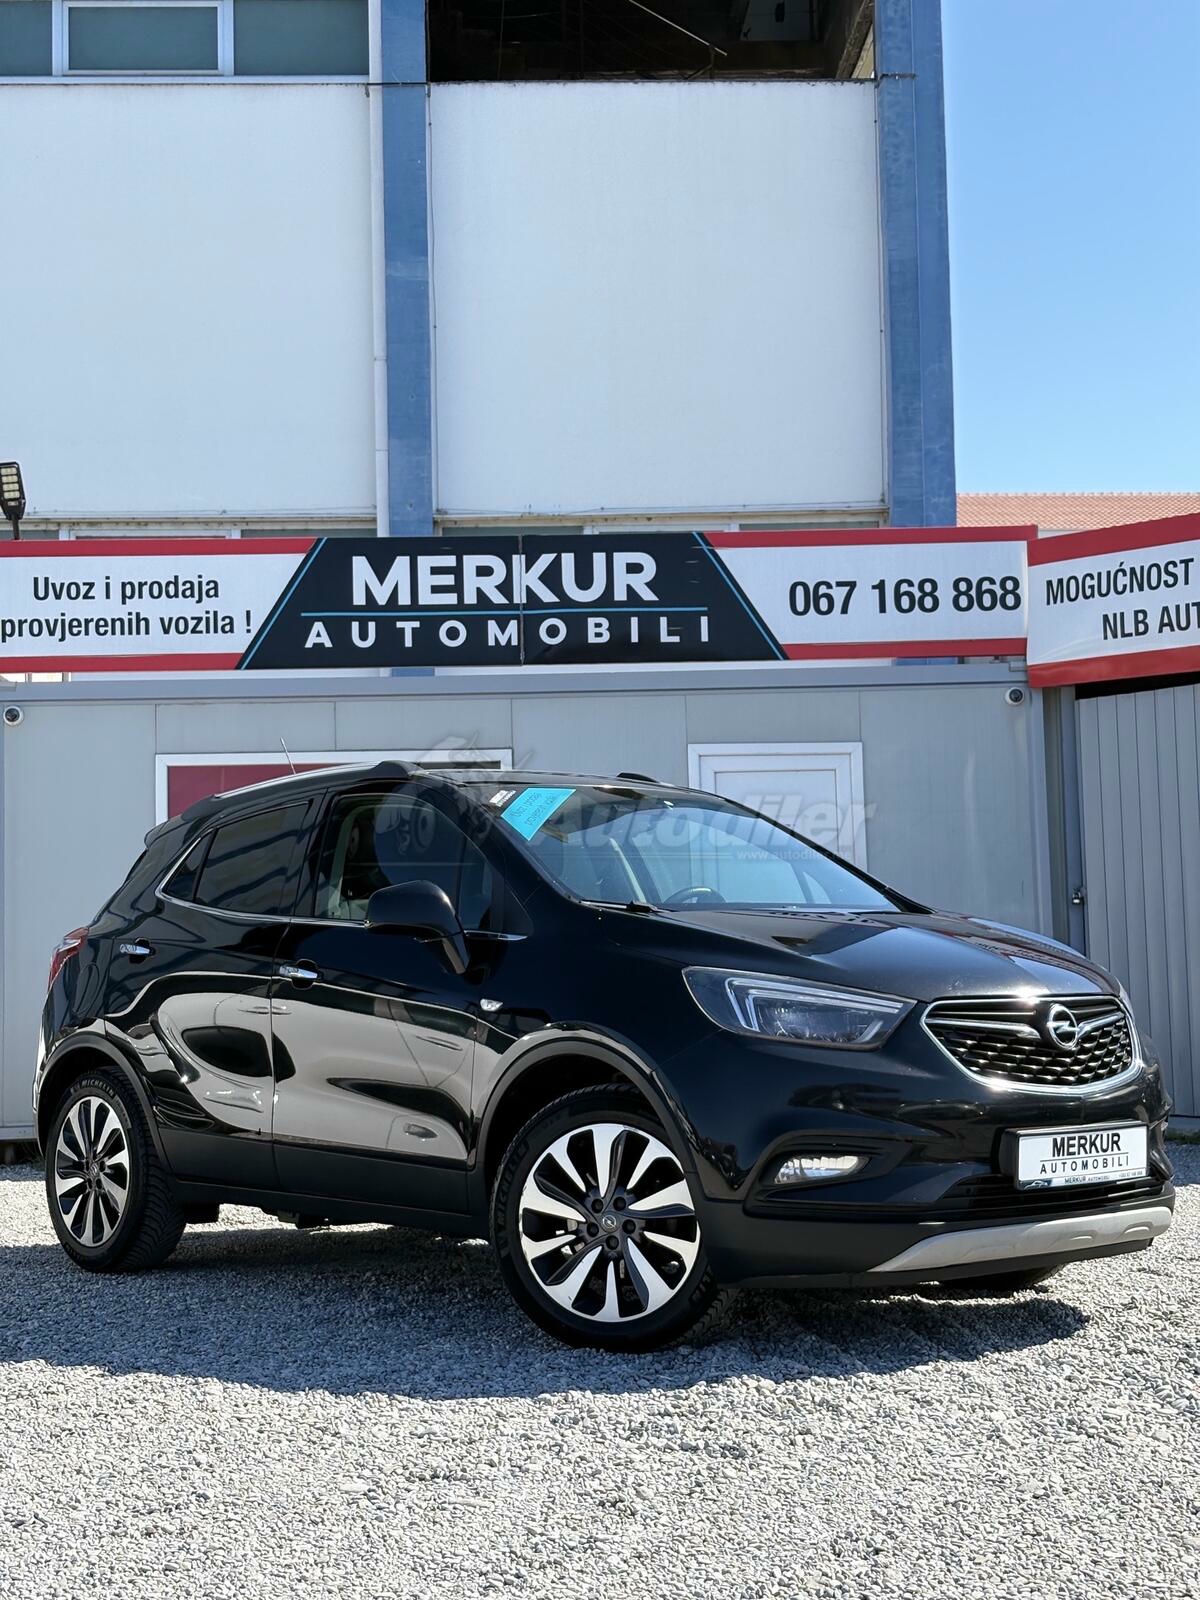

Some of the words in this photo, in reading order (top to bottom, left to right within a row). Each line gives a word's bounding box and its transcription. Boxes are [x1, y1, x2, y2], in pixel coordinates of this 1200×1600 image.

[33, 576, 96, 601] Uvoz
[104, 575, 111, 600] i
[120, 574, 220, 606] prodaja
[352, 552, 660, 605] MERKUR
[1046, 557, 1195, 606] MOGUĆNOST
[788, 580, 857, 617] 067
[871, 577, 940, 614] 168
[952, 575, 1022, 613] 868
[1, 612, 150, 643] provjerenih
[160, 610, 235, 635] vozila
[302, 614, 710, 649] AUTOMOBILI
[1102, 608, 1150, 641] NLB
[82, 1079, 115, 1097] MICHELIN
[1052, 1132, 1121, 1158] MERKUR
[1039, 1155, 1130, 1175] AUTOMOBILI
